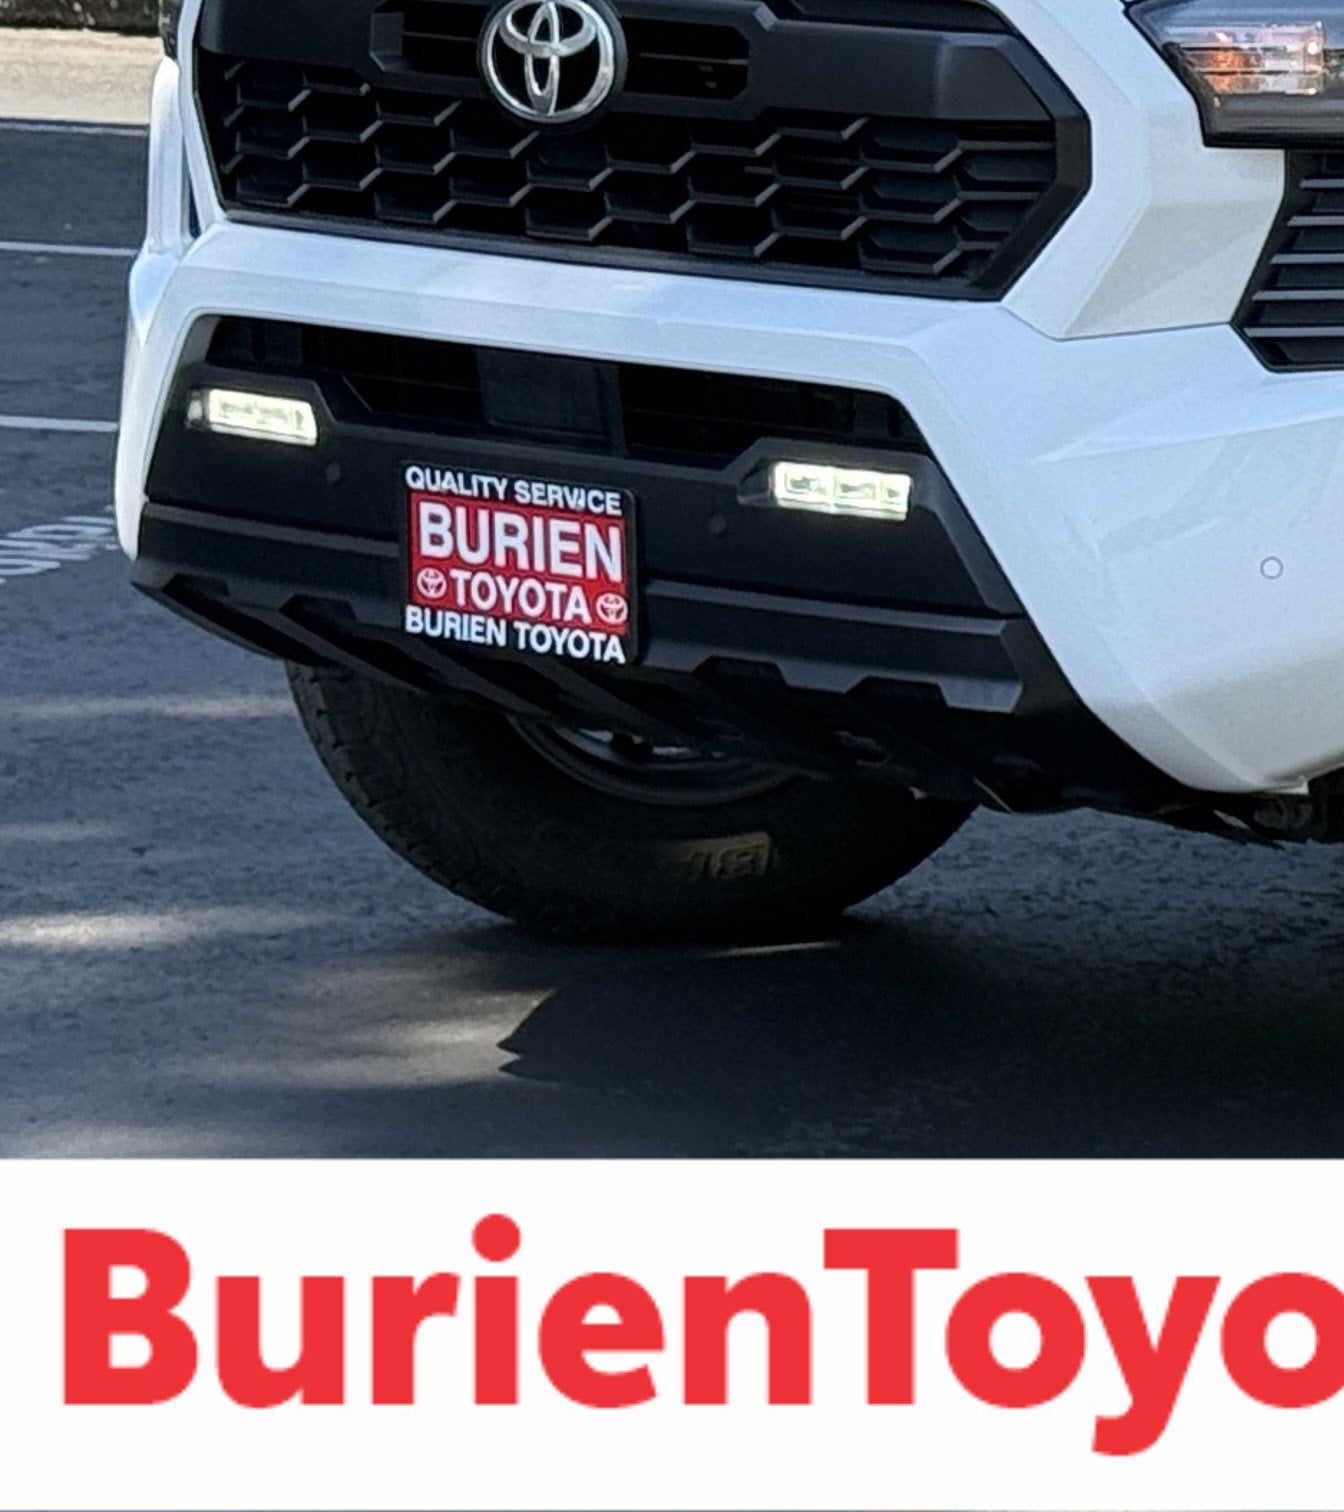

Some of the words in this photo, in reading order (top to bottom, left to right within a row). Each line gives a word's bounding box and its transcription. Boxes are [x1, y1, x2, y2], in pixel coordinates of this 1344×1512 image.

[405, 465, 508, 501] QUALITY
[513, 479, 623, 516] SERVICE
[418, 500, 623, 583] BURIEN
[449, 568, 593, 625] TOYOTA
[405, 605, 507, 648] BURIEN
[512, 621, 627, 665] TOYOTA
